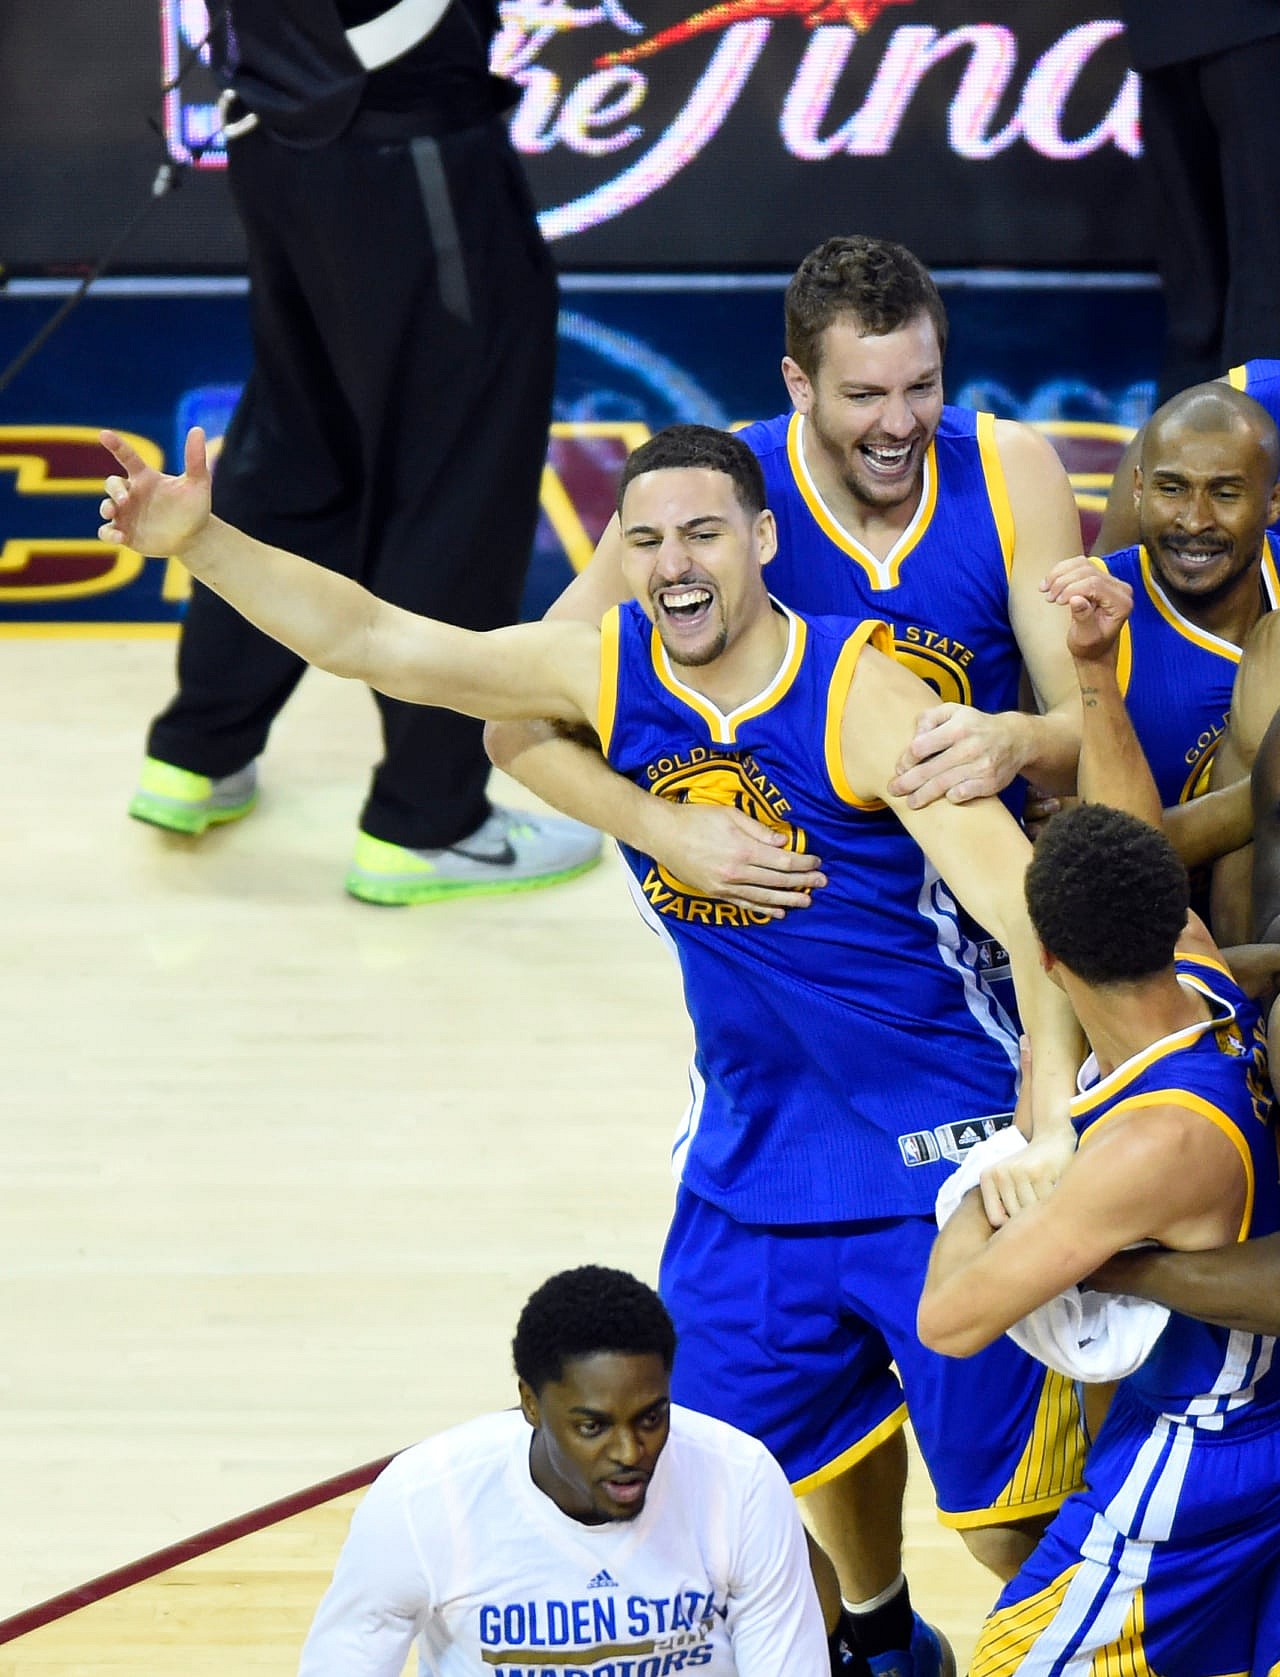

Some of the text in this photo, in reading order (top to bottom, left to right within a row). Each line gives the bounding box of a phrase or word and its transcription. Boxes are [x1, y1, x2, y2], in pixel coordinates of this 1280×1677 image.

[905, 625, 975, 667] STATE
[646, 746, 793, 816] GOLDEN STATE
[480, 1596, 617, 1646] GOLDEN
